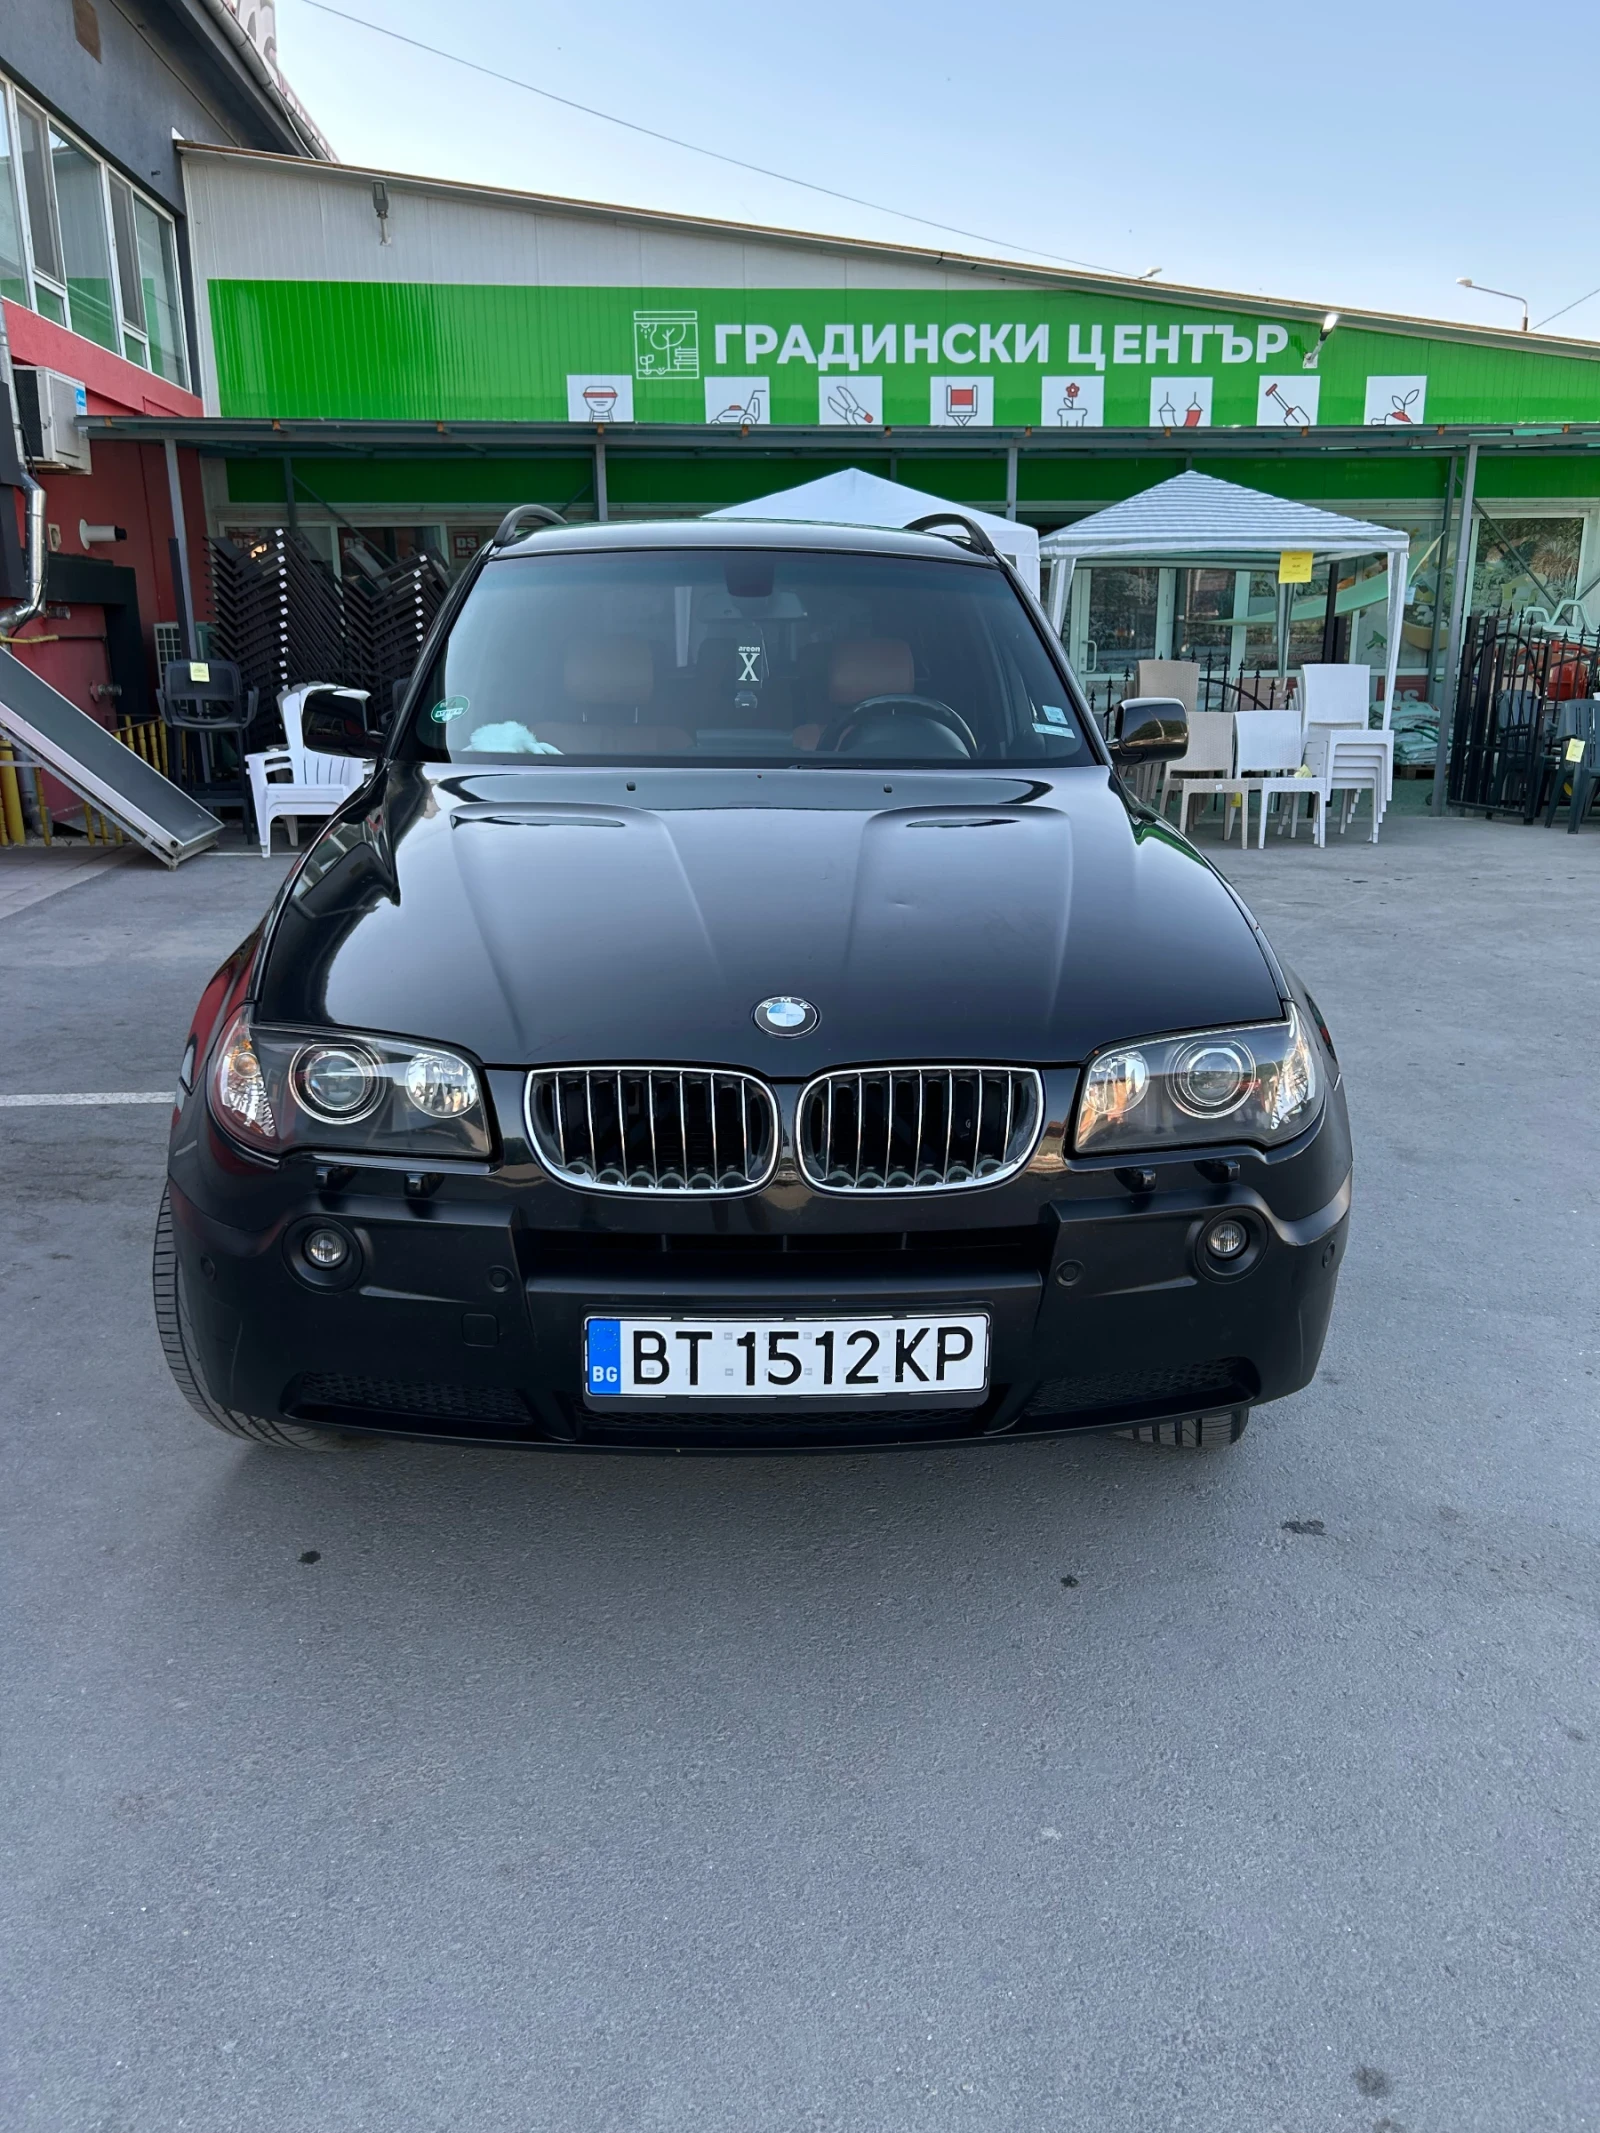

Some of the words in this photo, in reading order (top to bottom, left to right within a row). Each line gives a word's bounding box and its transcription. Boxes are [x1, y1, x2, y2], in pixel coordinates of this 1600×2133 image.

[714, 323, 1050, 371] ГРАДИНСКИ
[1068, 323, 1288, 371] ЦЕНТЪР
[738, 652, 760, 682] X
[761, 997, 811, 1009] BMW
[632, 1330, 713, 1386] BT
[736, 1329, 880, 1386] 1512
[895, 1326, 974, 1383] KP
[592, 1366, 618, 1383] BG
